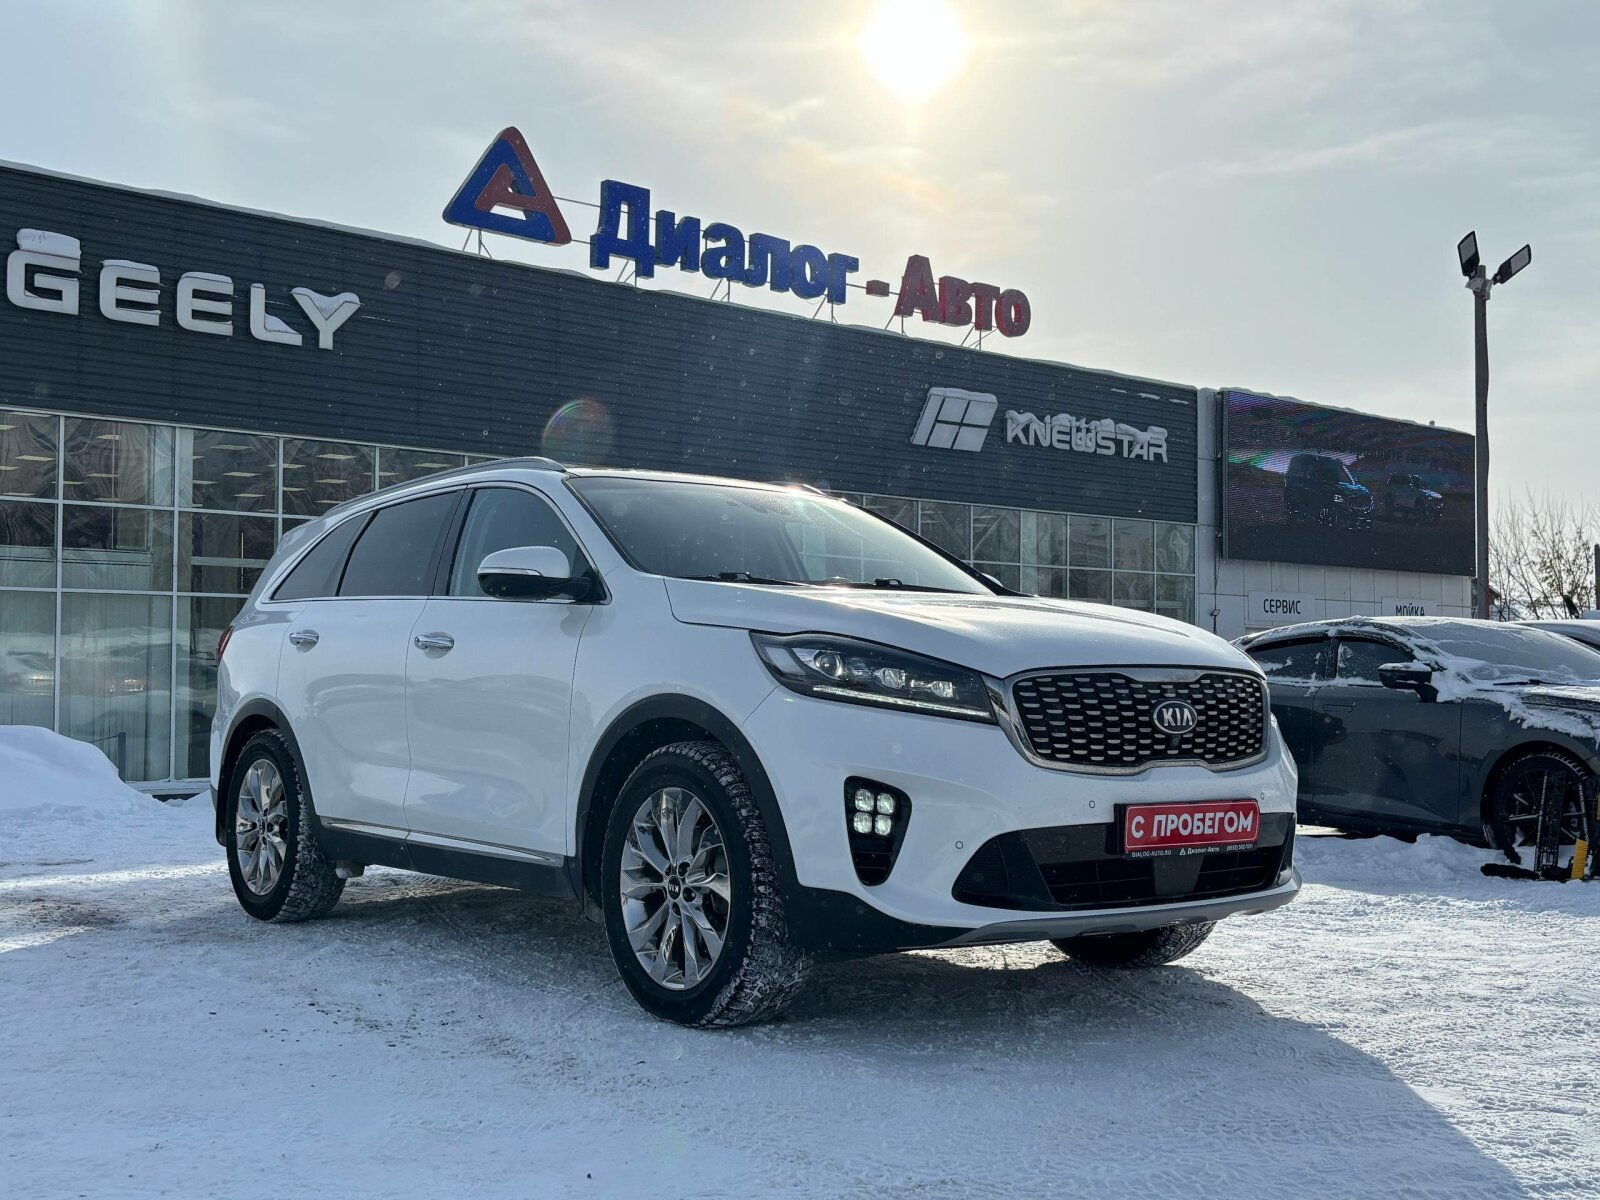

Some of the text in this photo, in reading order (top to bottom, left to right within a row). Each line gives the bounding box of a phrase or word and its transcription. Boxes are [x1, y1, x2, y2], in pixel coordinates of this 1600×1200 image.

[590, 179, 1031, 338] Диалог-Авто
[6, 244, 361, 350] GEELY
[1005, 411, 1168, 463] KNEWSTAR
[1263, 598, 1301, 615] СЕРВИС
[1395, 602, 1425, 617] МОЙКА
[1161, 707, 1193, 727] KIA
[1131, 810, 1254, 839] С ПРОБЕГОМ
